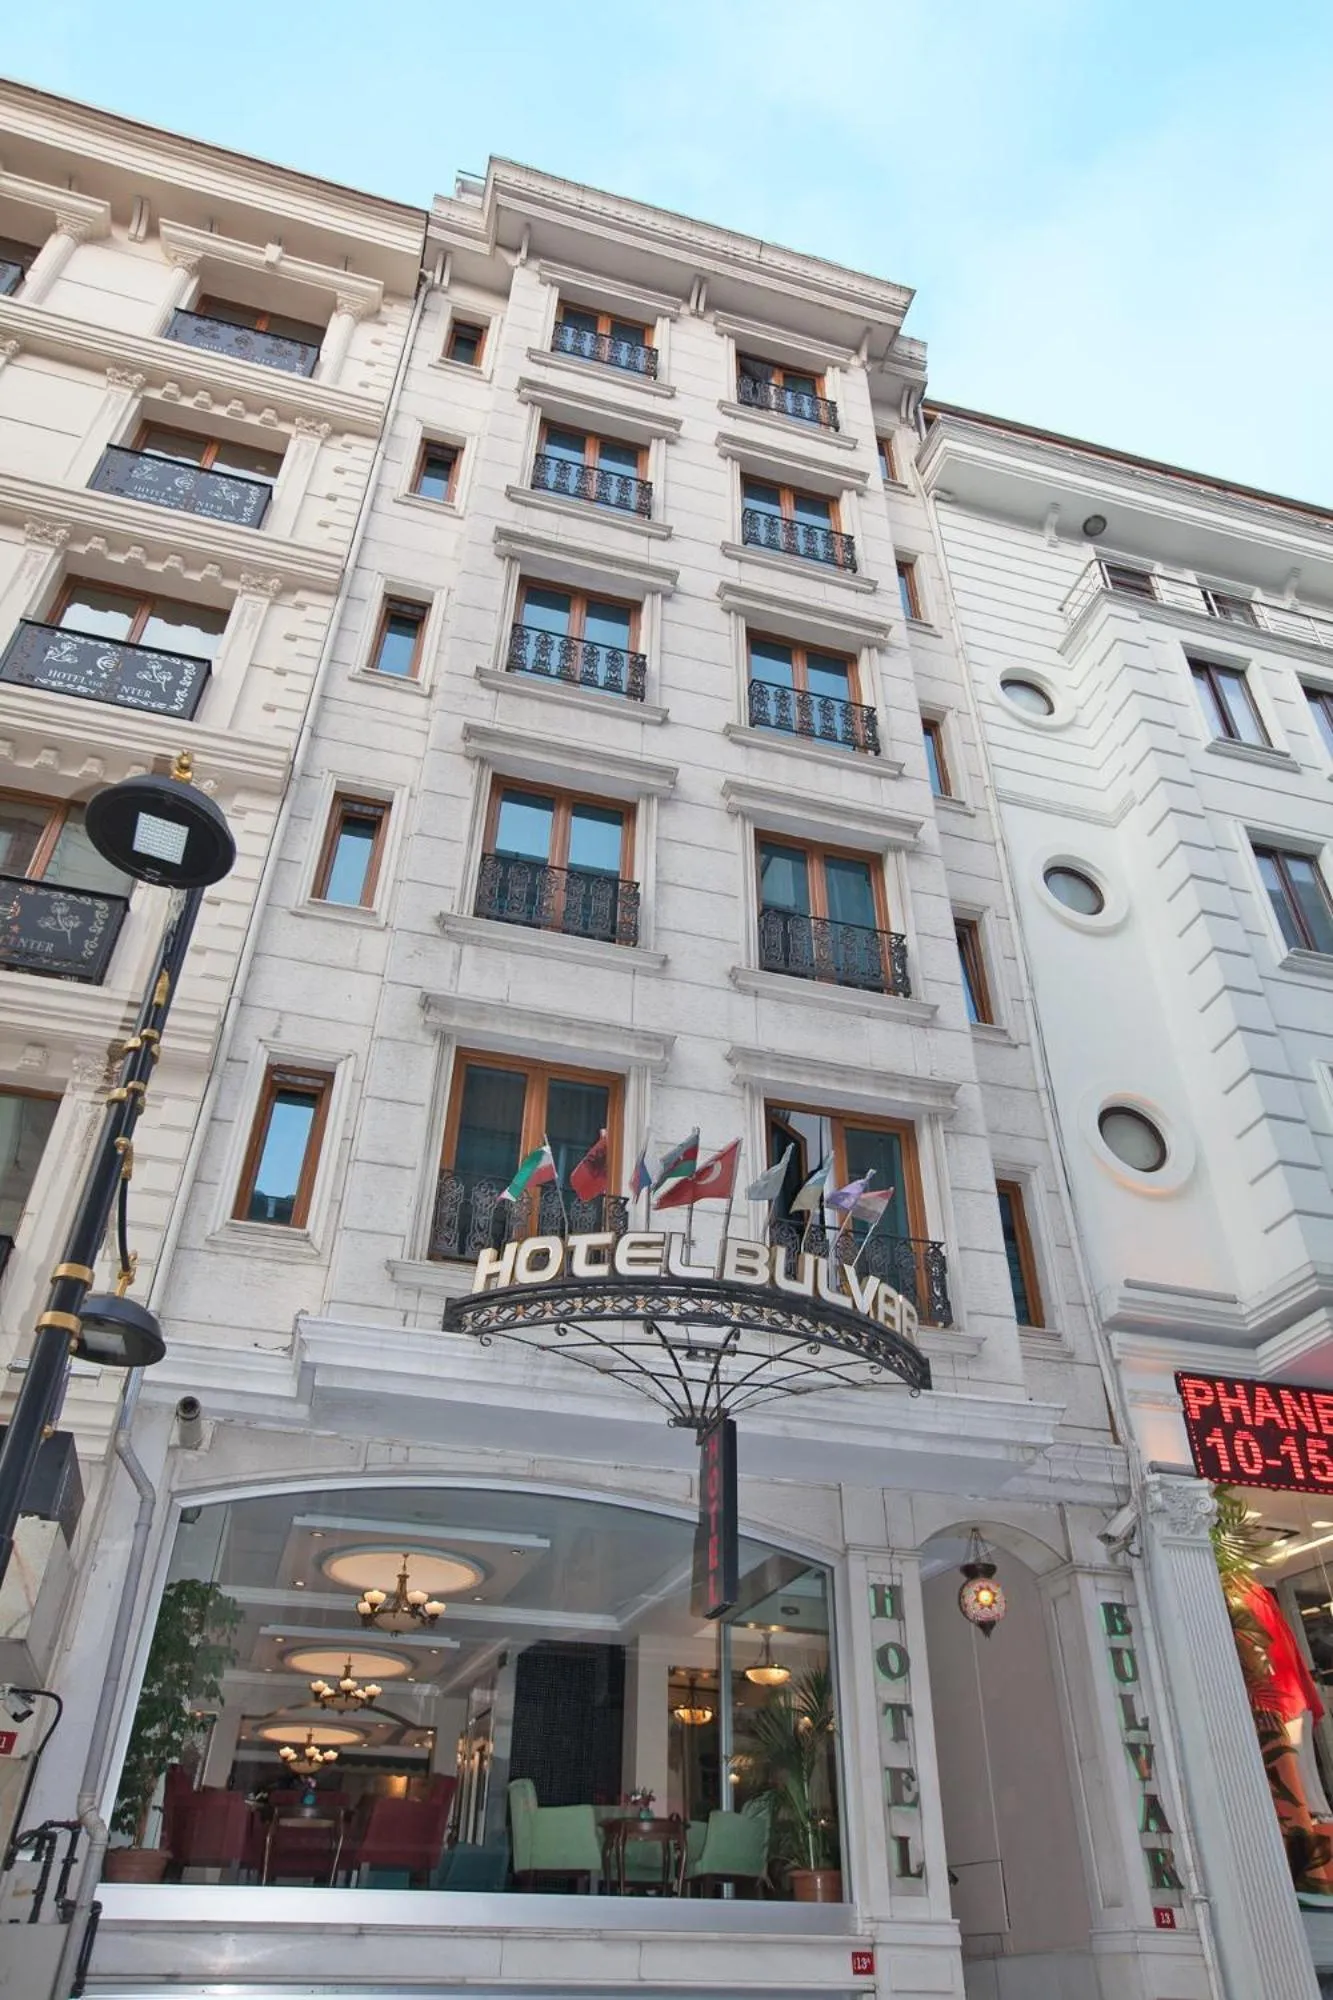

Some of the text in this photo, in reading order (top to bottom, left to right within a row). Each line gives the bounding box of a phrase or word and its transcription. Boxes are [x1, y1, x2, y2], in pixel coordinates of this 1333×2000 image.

[47, 668, 87, 685] HOTEL
[472, 1231, 919, 1345] HOTEL BULVAR
[1184, 1378, 1333, 1434] PHANE
[1205, 1427, 1333, 1482] 10-15
[706, 1433, 721, 1606] HOTEL
[867, 1583, 926, 1878] HOTEL
[1100, 1601, 1184, 1889] BULVAR
